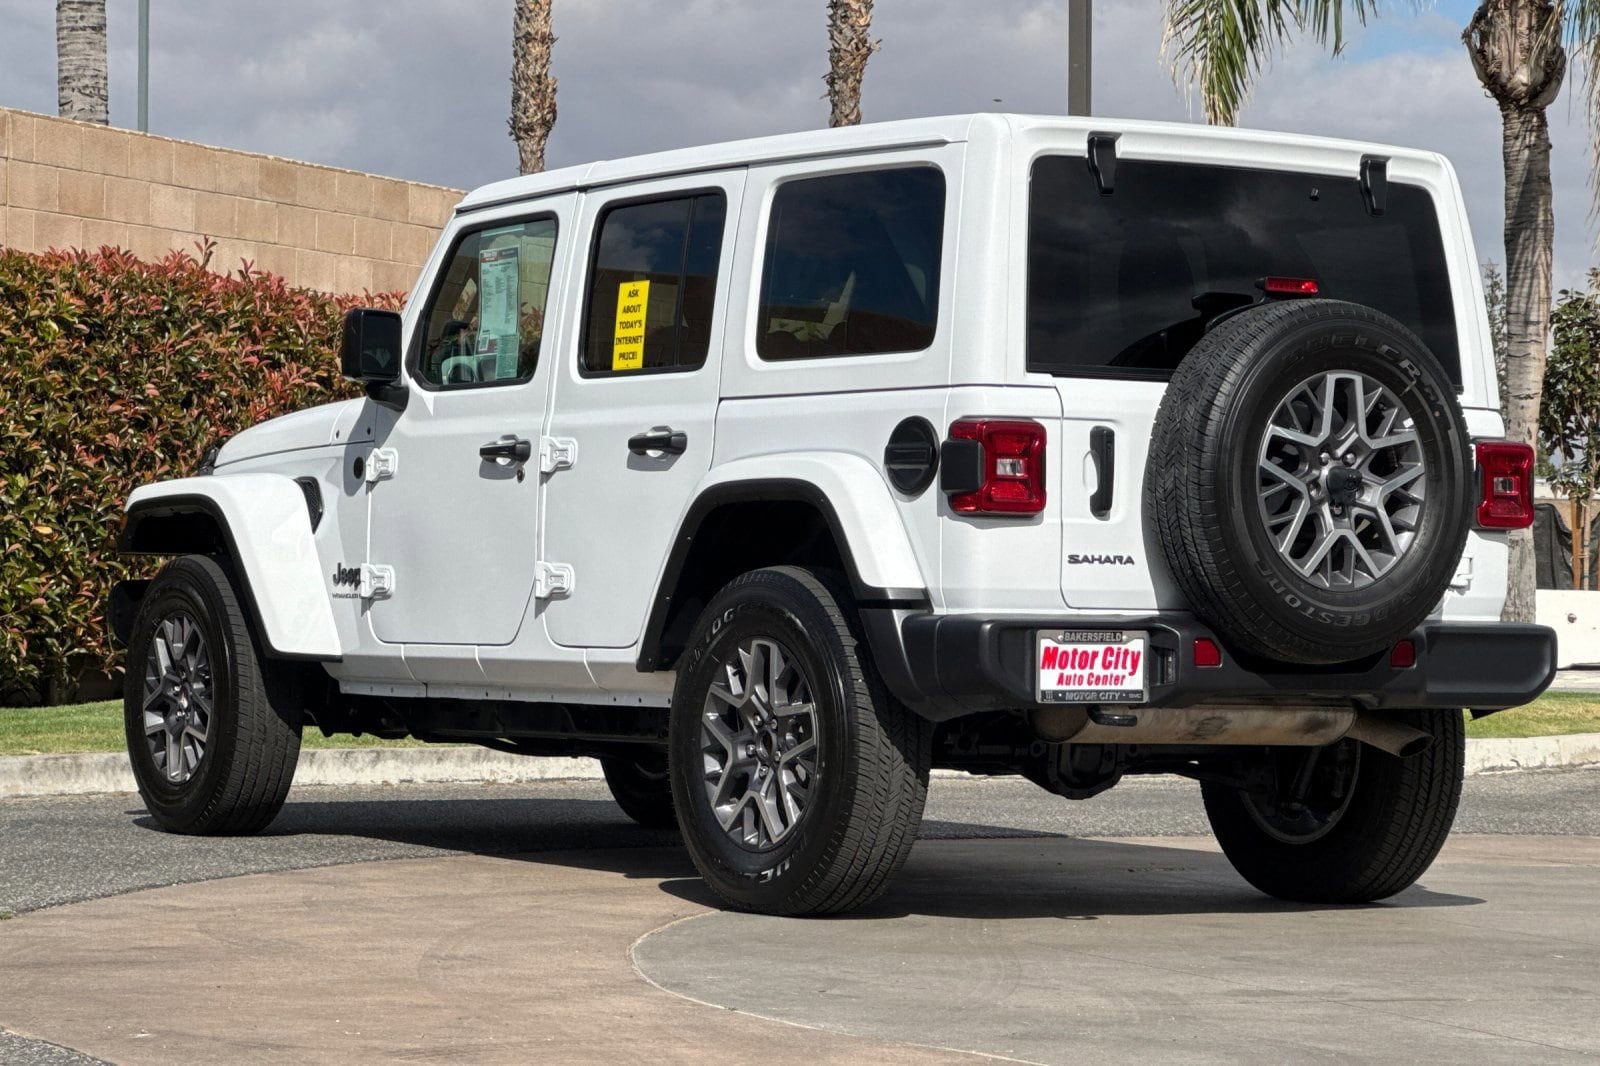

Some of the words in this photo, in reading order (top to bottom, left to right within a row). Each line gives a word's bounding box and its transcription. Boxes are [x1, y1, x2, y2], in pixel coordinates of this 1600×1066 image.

[628, 289, 640, 298] ASK
[622, 304, 642, 314] ABOUT
[620, 320, 642, 330] TODAY'S
[615, 335, 643, 346] INTERNET
[618, 351, 638, 361] PRICE!
[1067, 554, 1135, 565] SAHARA
[332, 562, 362, 591] Jeep
[1064, 632, 1122, 642] BAKERSFIELD
[1041, 646, 1099, 670] Motor
[1102, 646, 1141, 676] City
[1056, 672, 1084, 686] Auto
[1086, 672, 1126, 686] Center
[1065, 692, 1097, 701] MOTOR
[1098, 692, 1120, 701] CITY
